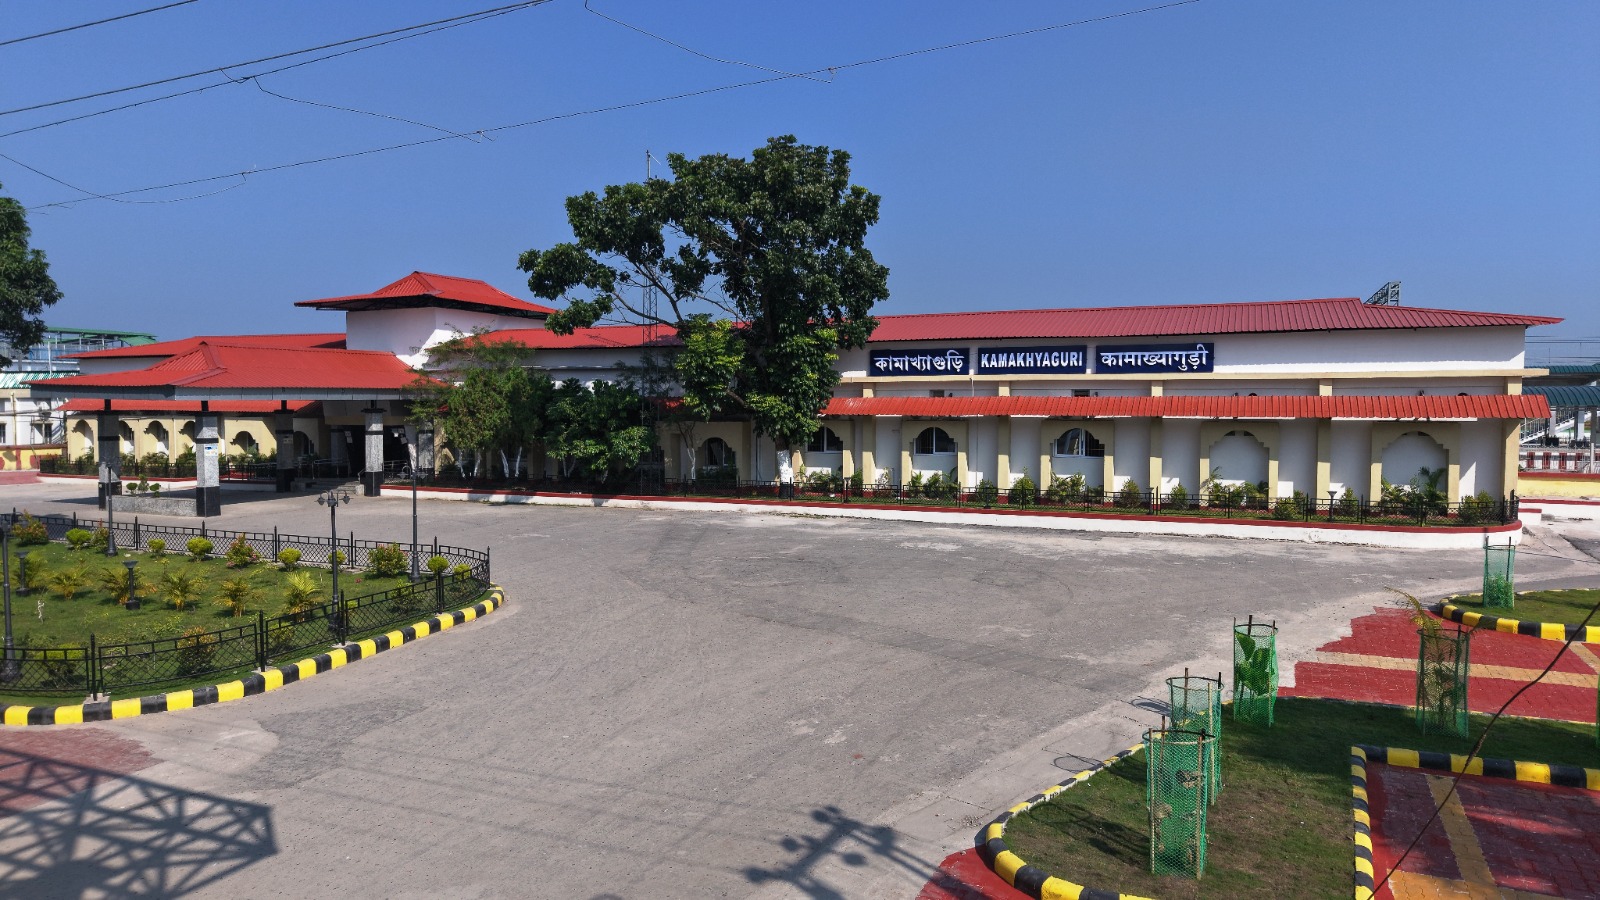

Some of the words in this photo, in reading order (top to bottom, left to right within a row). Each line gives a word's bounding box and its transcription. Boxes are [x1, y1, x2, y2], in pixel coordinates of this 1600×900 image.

[873, 349, 965, 372] কামাখ্যাগুড়ি
[981, 351, 1083, 368] KAMAKHYAGURI
[1099, 343, 1209, 371] कामाख्यागुड़ी
